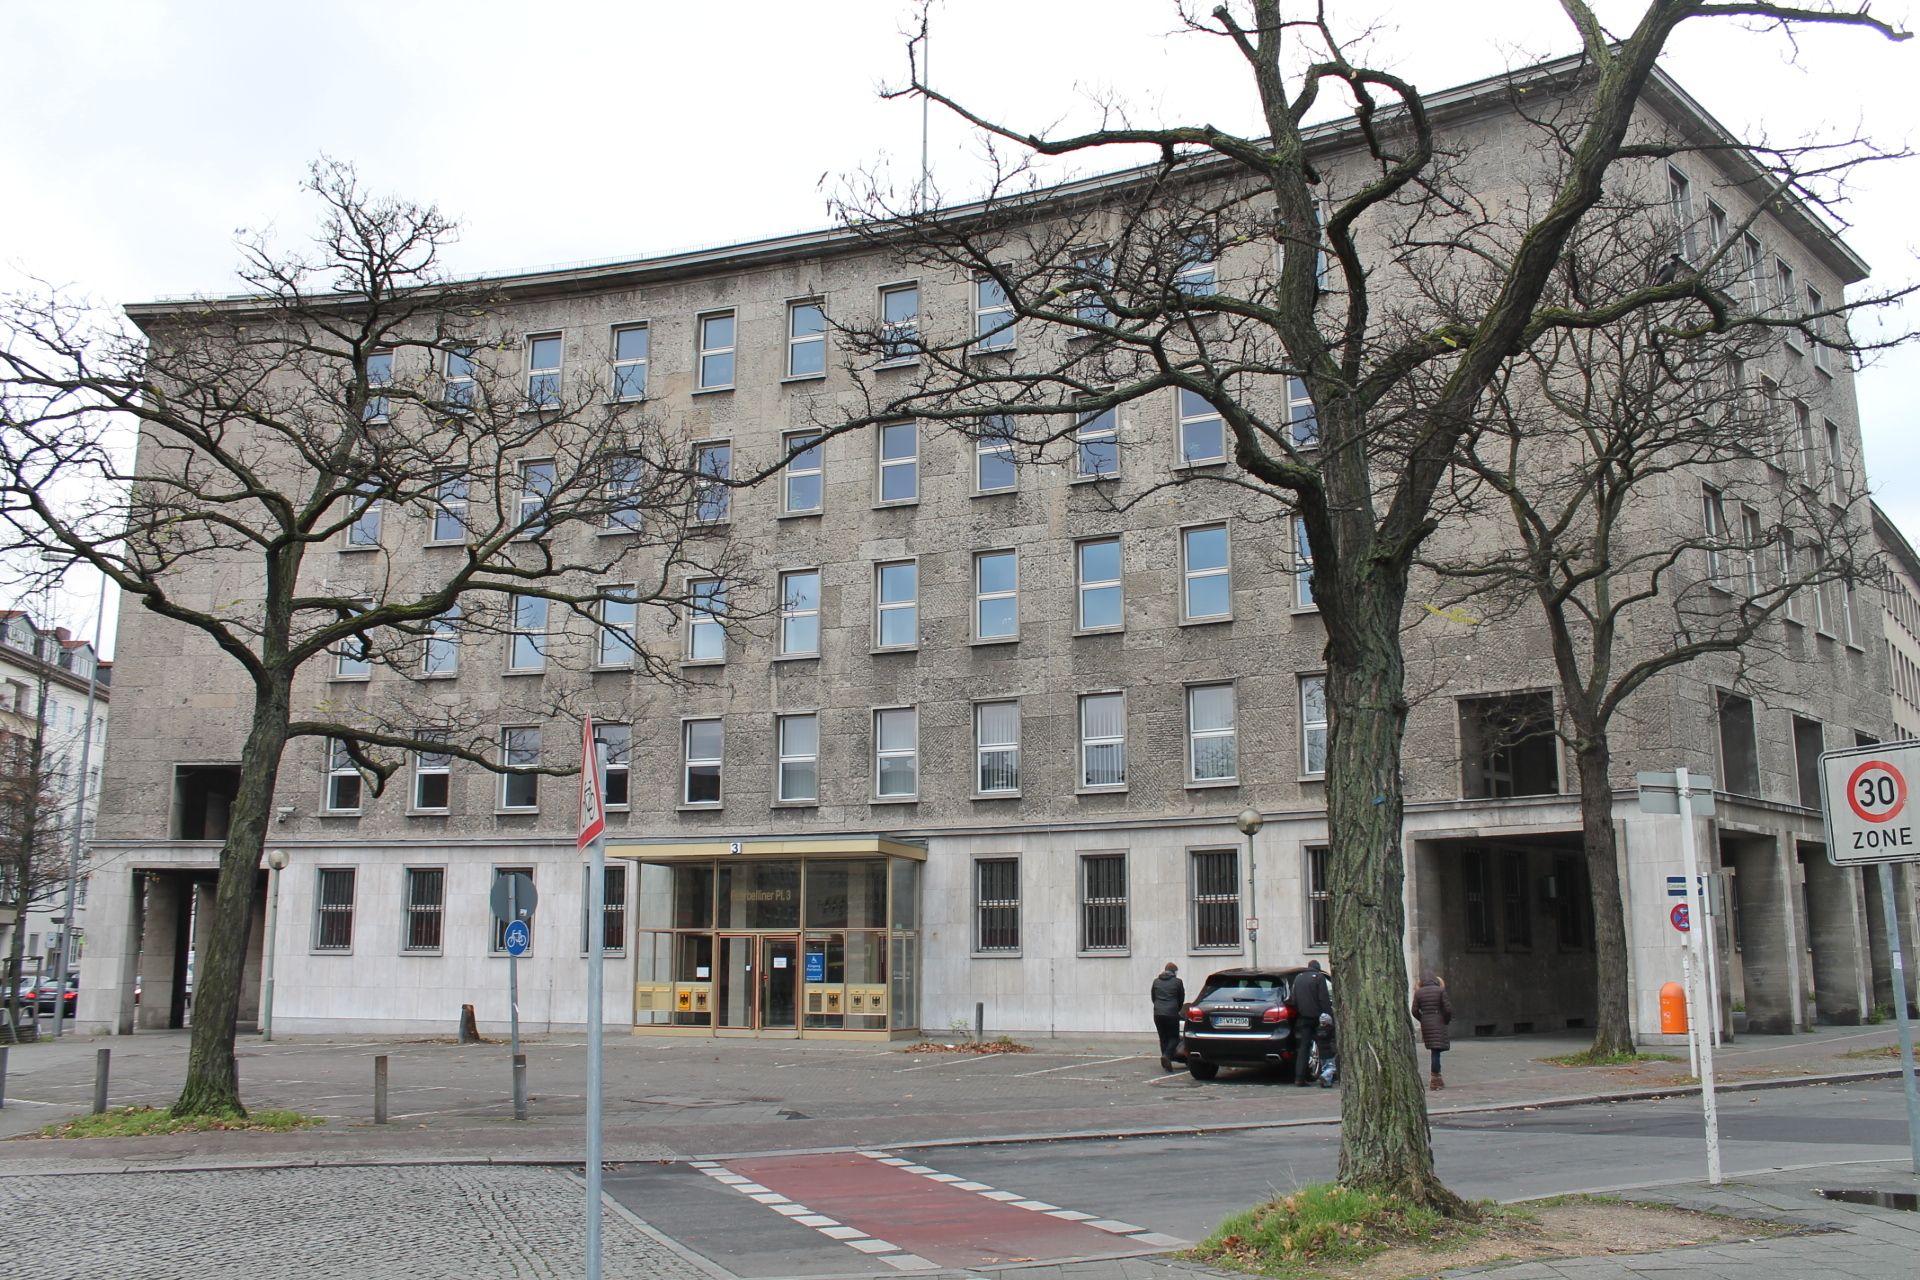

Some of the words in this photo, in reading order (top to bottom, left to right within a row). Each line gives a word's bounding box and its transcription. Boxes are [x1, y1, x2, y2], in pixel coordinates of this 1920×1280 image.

[1858, 776, 1895, 807] 30
[1852, 827, 1913, 849] ZONE
[731, 843, 739, 854] 3
[786, 889, 792, 901] 3
